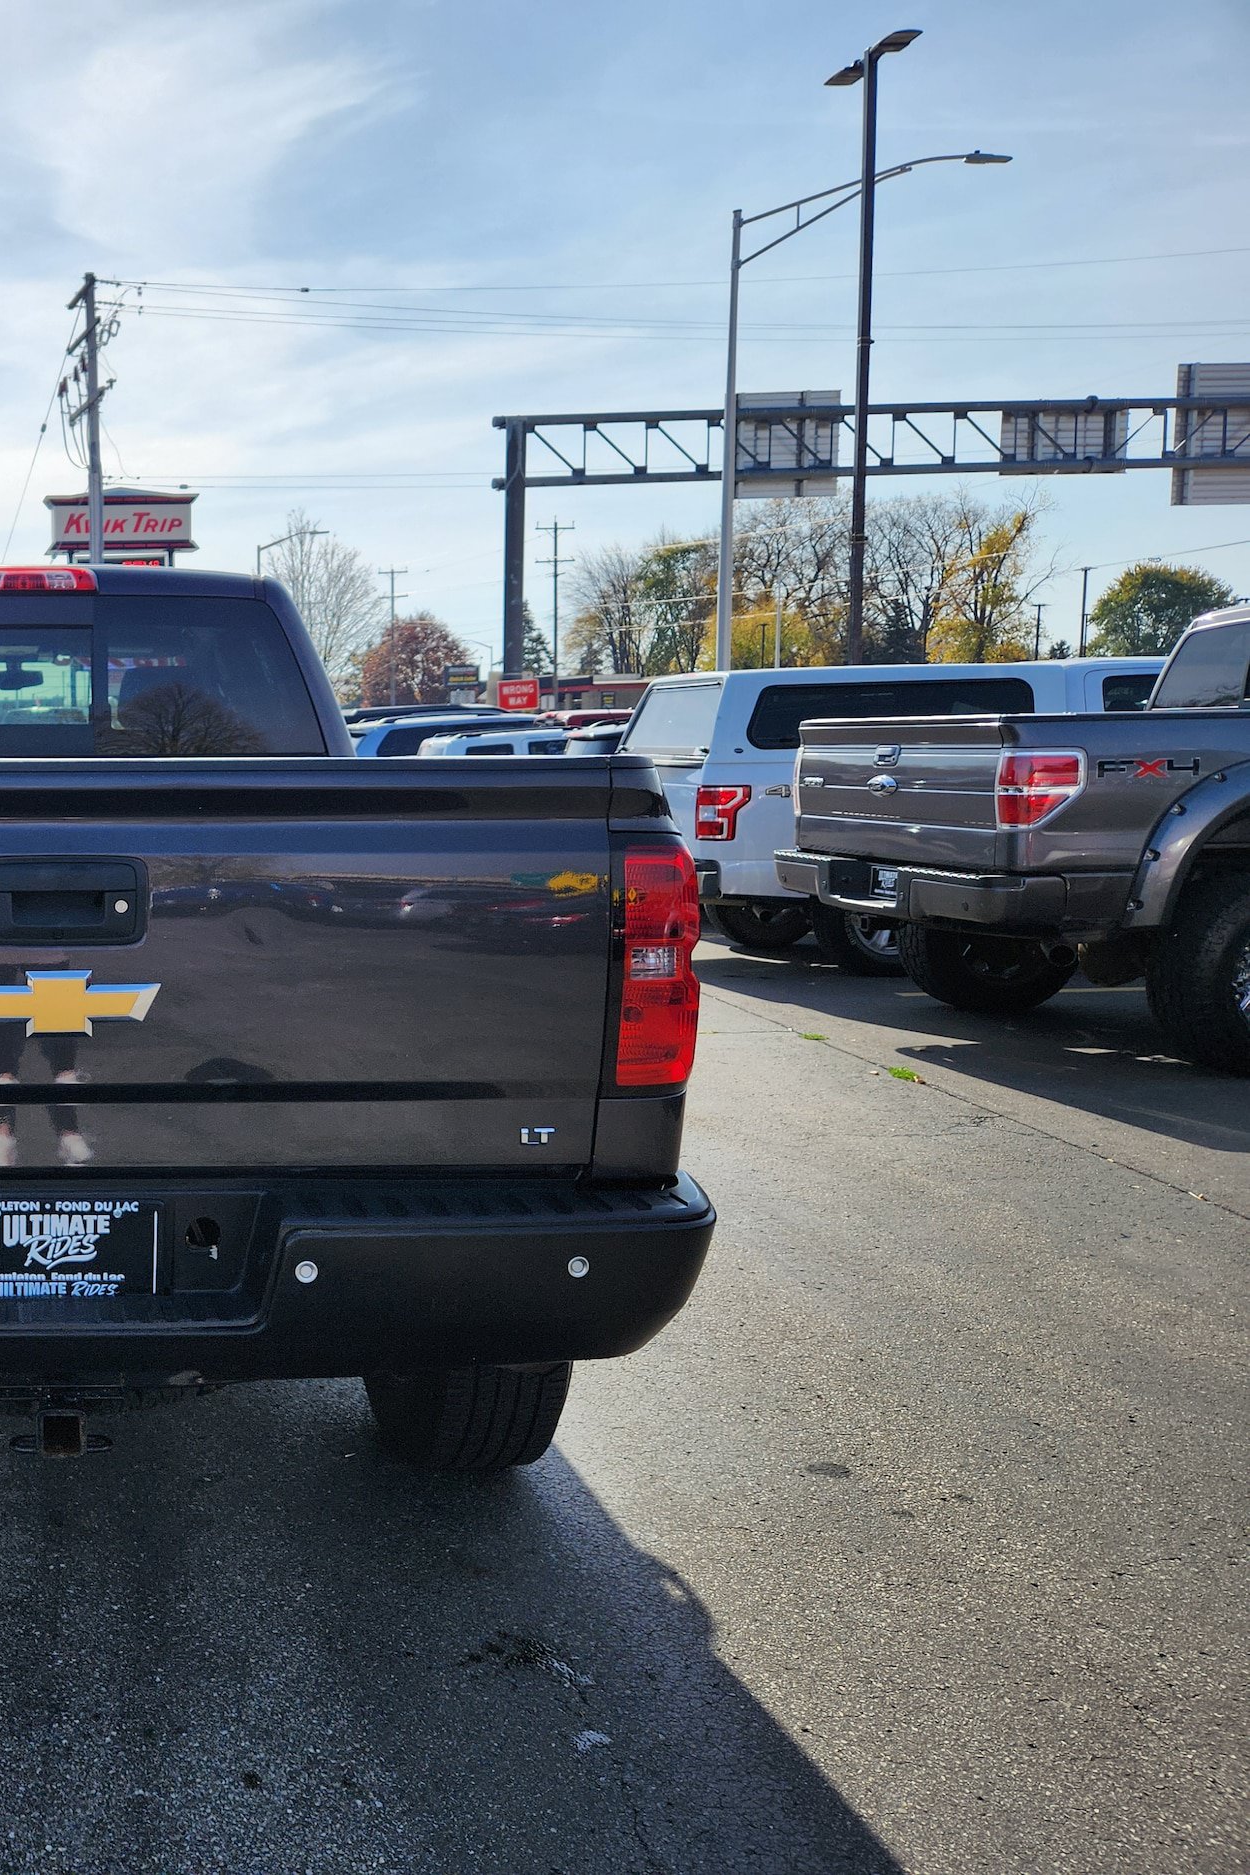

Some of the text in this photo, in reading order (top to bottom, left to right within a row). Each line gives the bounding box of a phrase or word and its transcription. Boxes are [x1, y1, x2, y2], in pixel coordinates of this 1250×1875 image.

[64, 512, 183, 534] KIK TRIP
[502, 684, 534, 695] WRONG
[508, 696, 528, 705] WAY
[1096, 757, 1200, 778] FX4
[520, 1127, 556, 1145] LT
[55, 1201, 91, 1212] FOND
[94, 1201, 113, 1212] DU
[115, 1201, 139, 1212] LAC
[2, 1214, 111, 1248] ULTIMATE
